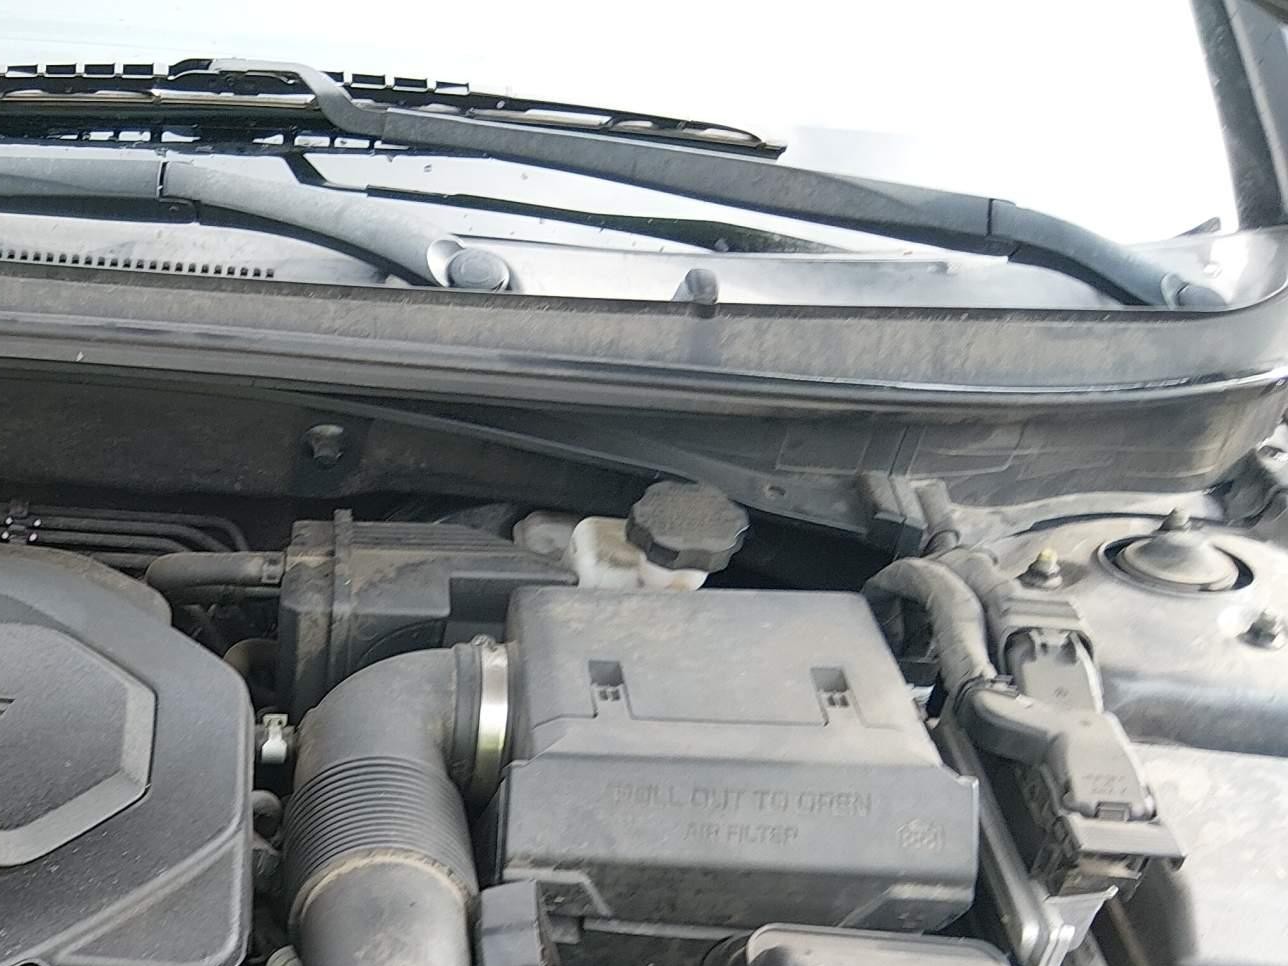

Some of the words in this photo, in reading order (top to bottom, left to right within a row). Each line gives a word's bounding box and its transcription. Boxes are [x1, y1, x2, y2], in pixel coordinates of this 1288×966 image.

[690, 786, 746, 811] OUT
[752, 788, 790, 813] TO
[797, 790, 872, 817] OPEN
[726, 823, 799, 847] FILTER
